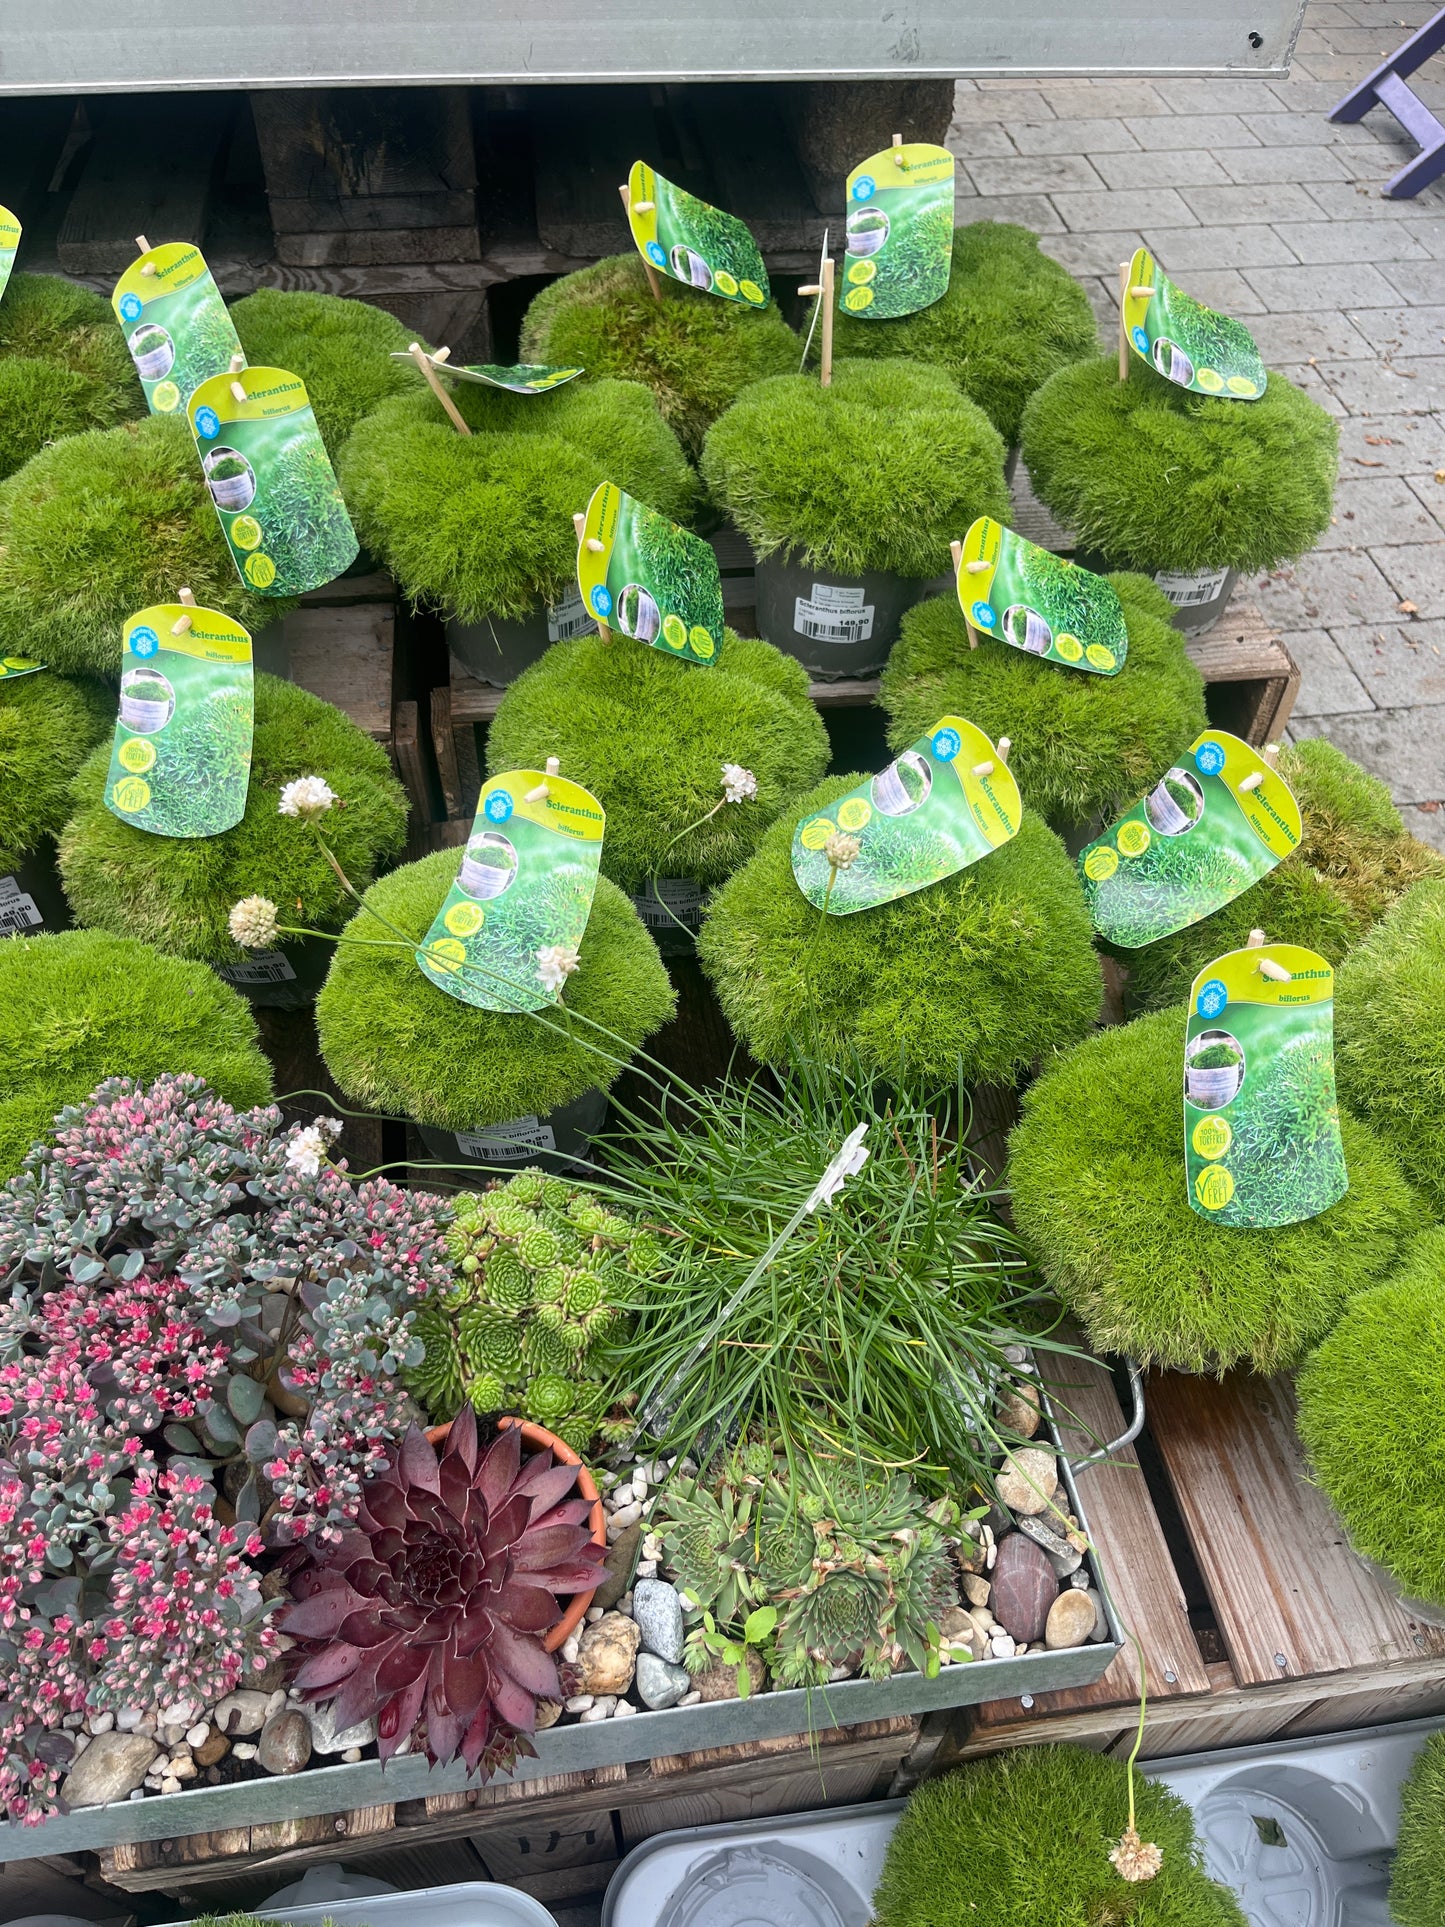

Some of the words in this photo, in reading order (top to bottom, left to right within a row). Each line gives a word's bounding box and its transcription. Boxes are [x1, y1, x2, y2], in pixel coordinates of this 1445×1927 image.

[155, 250, 199, 280] Scleranthus
[247, 381, 303, 401] cleranthus
[799, 600, 838, 615] Scleranthus
[190, 629, 249, 644] Scleranthus
[546, 799, 603, 821] Scleranthus
[980, 776, 1015, 835] Scleranthus
[1251, 787, 1298, 845] Scleranthus
[1278, 994, 1311, 1003] biflorus
[508, 1128, 541, 1139] biflorus
